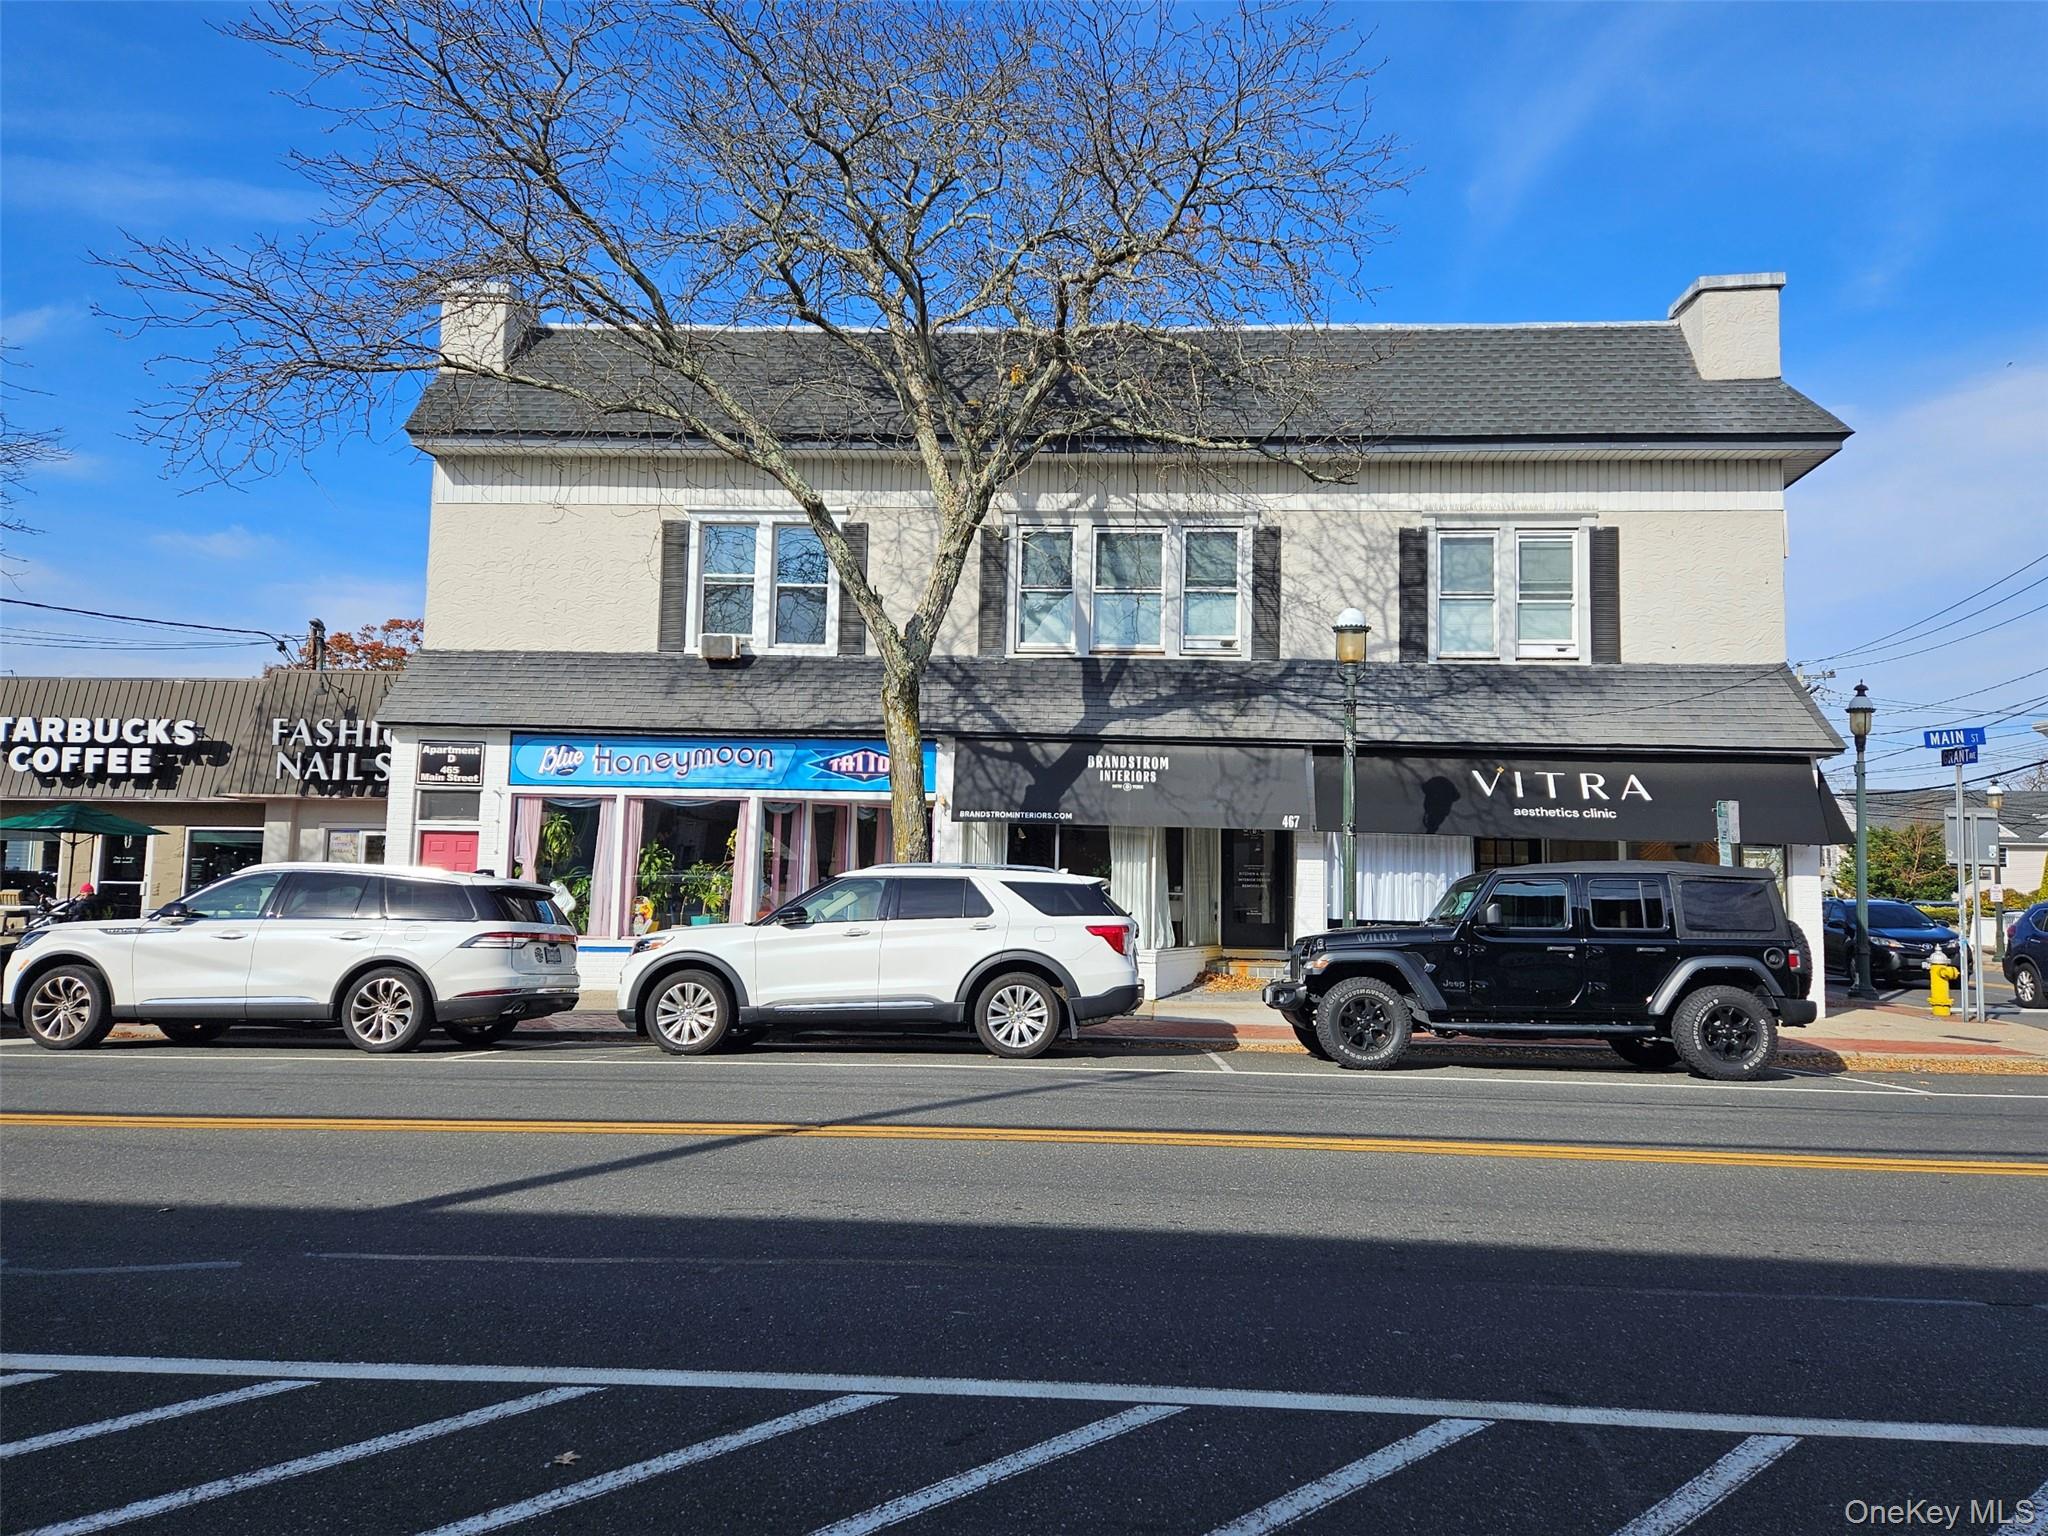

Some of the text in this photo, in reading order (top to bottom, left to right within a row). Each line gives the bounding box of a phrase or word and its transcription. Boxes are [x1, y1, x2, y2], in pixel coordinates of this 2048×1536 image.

[0, 716, 197, 746] TARBUCKS
[1930, 730, 1979, 745] MAIN ST
[422, 745, 480, 755] Apartment
[1943, 749, 1969, 764] GRANT
[8, 746, 152, 774] COFFEE
[447, 754, 457, 763] D
[538, 744, 775, 779] Blue Honeymoon
[828, 750, 889, 773] TATTO
[1087, 754, 1169, 770] BRANDSTROM
[276, 751, 391, 781] NAILS
[420, 772, 479, 782] Main Street
[1099, 769, 1157, 783] INTERIORS
[1471, 769, 1653, 801] VITRA
[959, 810, 1073, 820] BRANDSTROMINTERIORS.COM
[1513, 807, 1617, 819] aesthetics clinic
[1281, 815, 1300, 828] 467
[1357, 932, 1399, 943] WILLYS
[1442, 979, 1466, 989] Jeep
